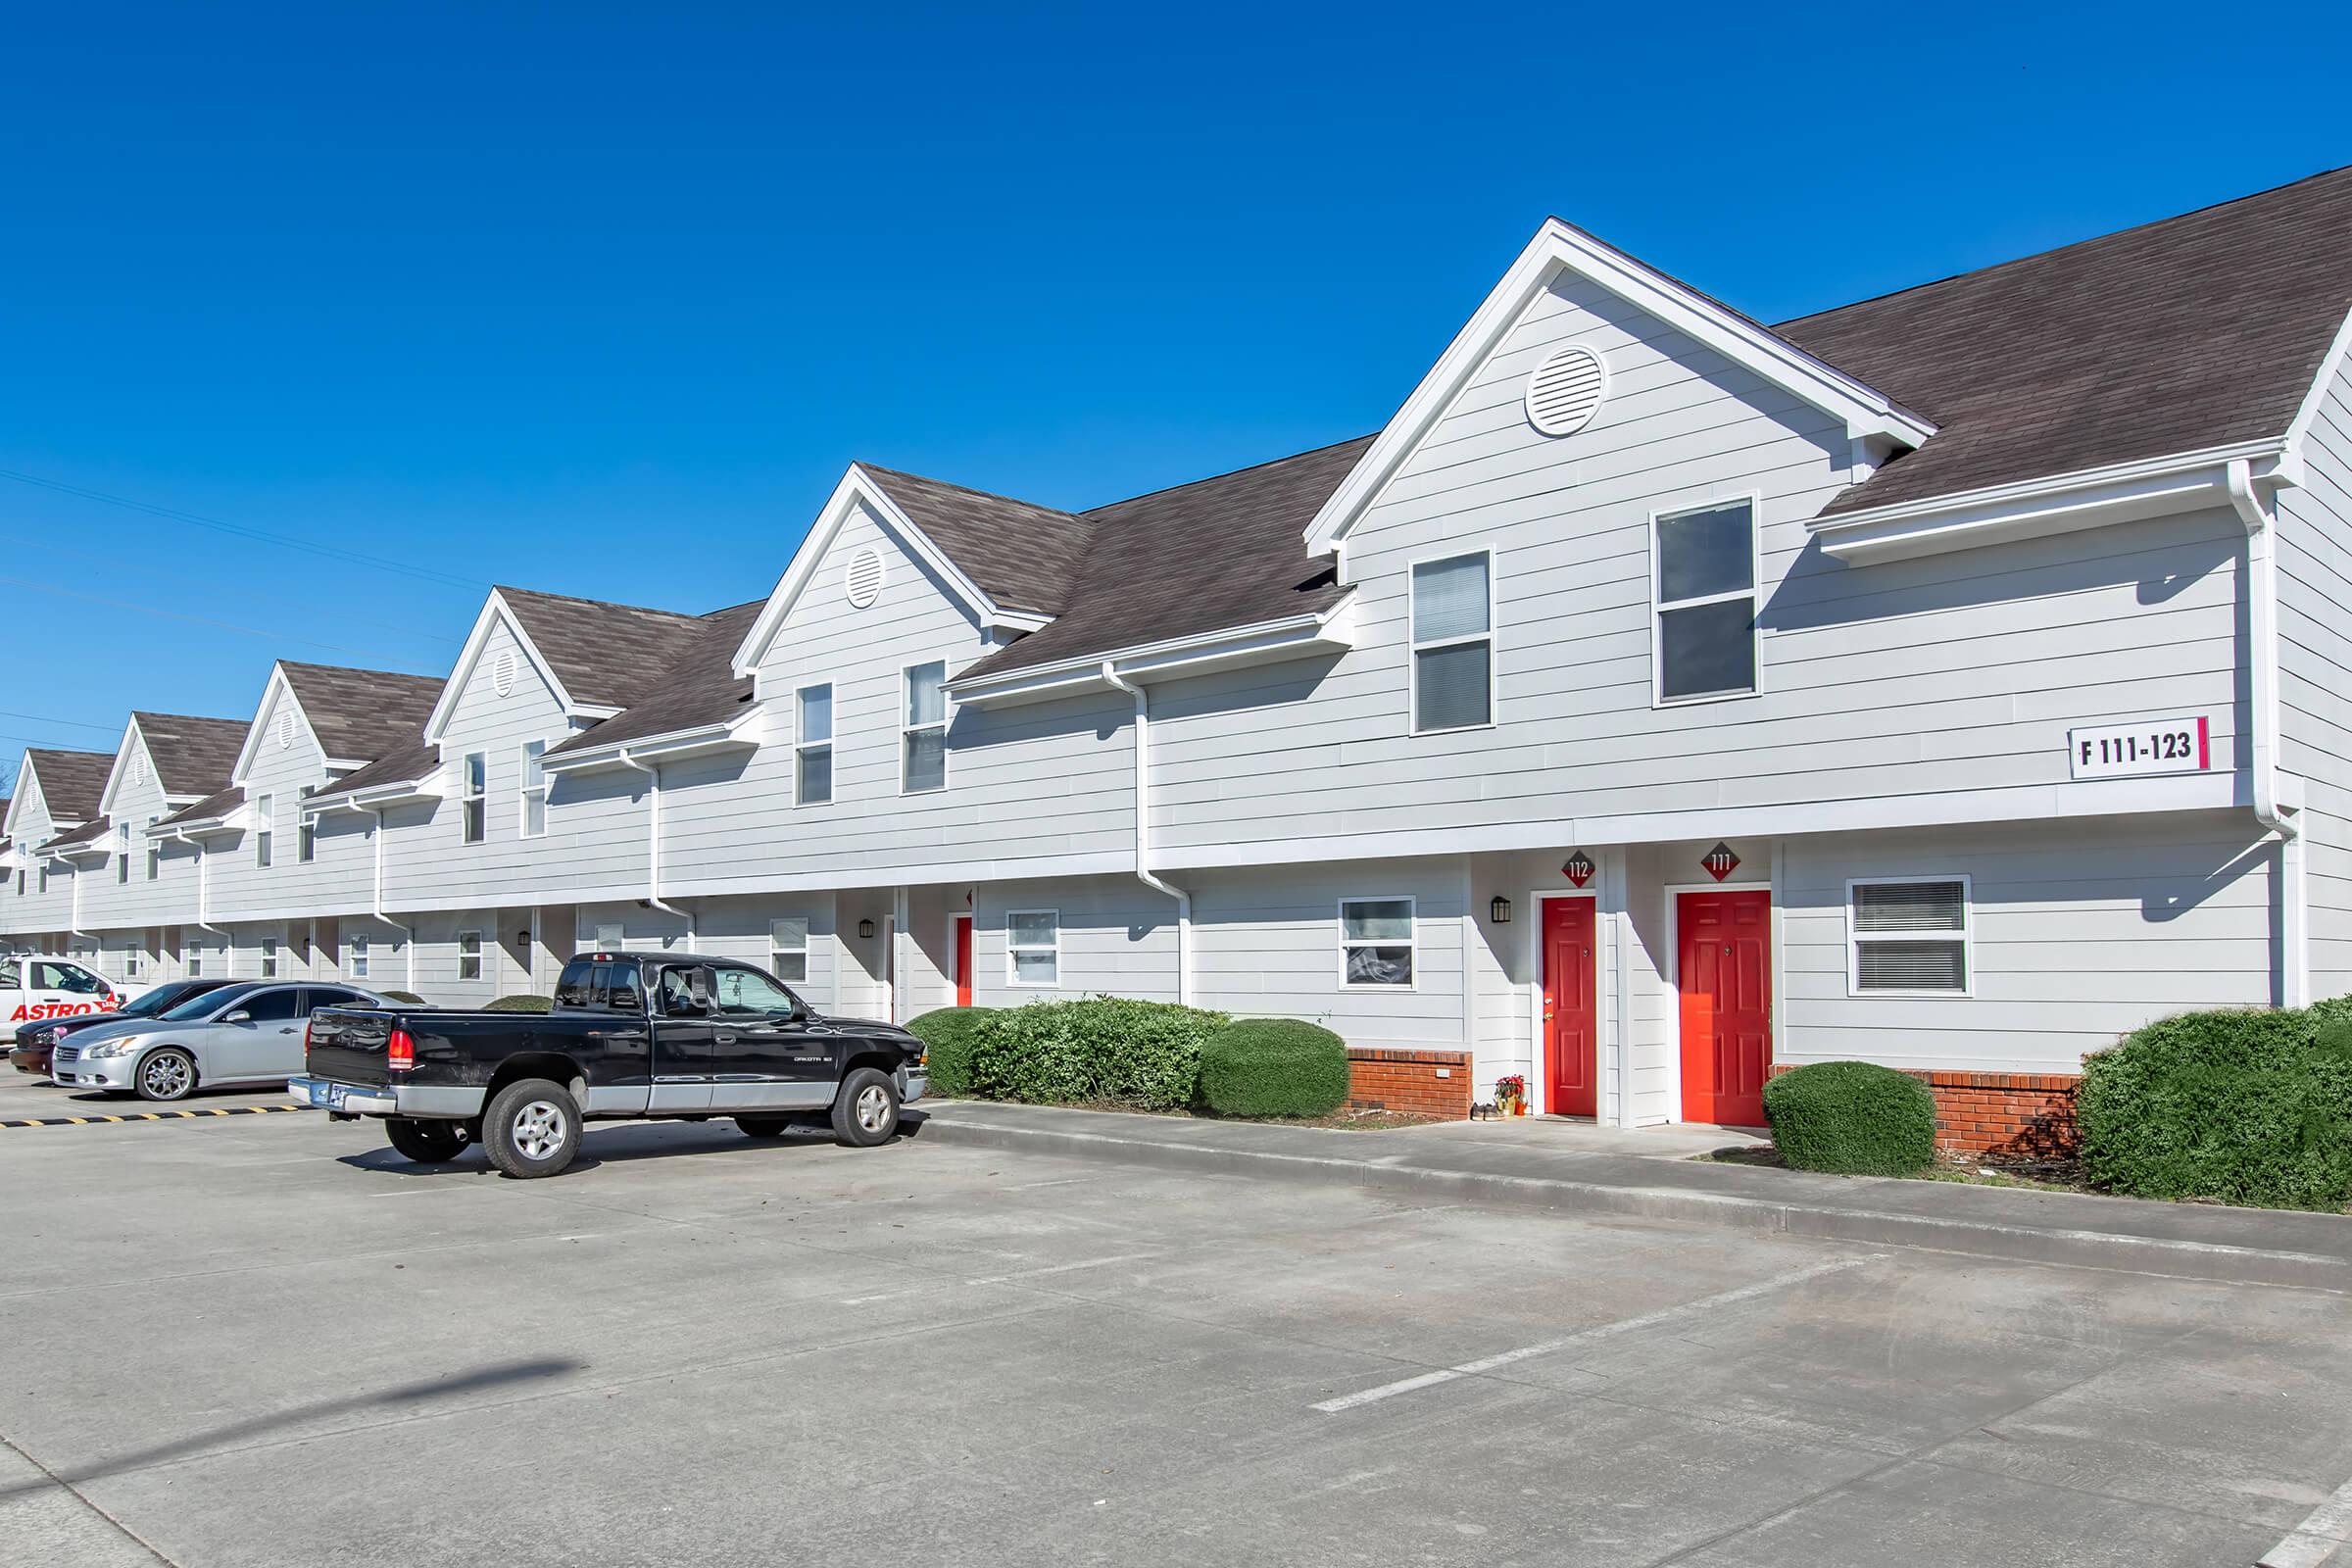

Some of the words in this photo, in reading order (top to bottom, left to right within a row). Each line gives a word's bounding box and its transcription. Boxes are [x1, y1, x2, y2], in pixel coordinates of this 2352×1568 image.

[2082, 741, 2091, 765] F
[2100, 732, 2191, 763] 111-123
[1569, 861, 1588, 877] 112
[1711, 854, 1730, 870] 111
[10, 1004, 91, 1020] ASTRO
